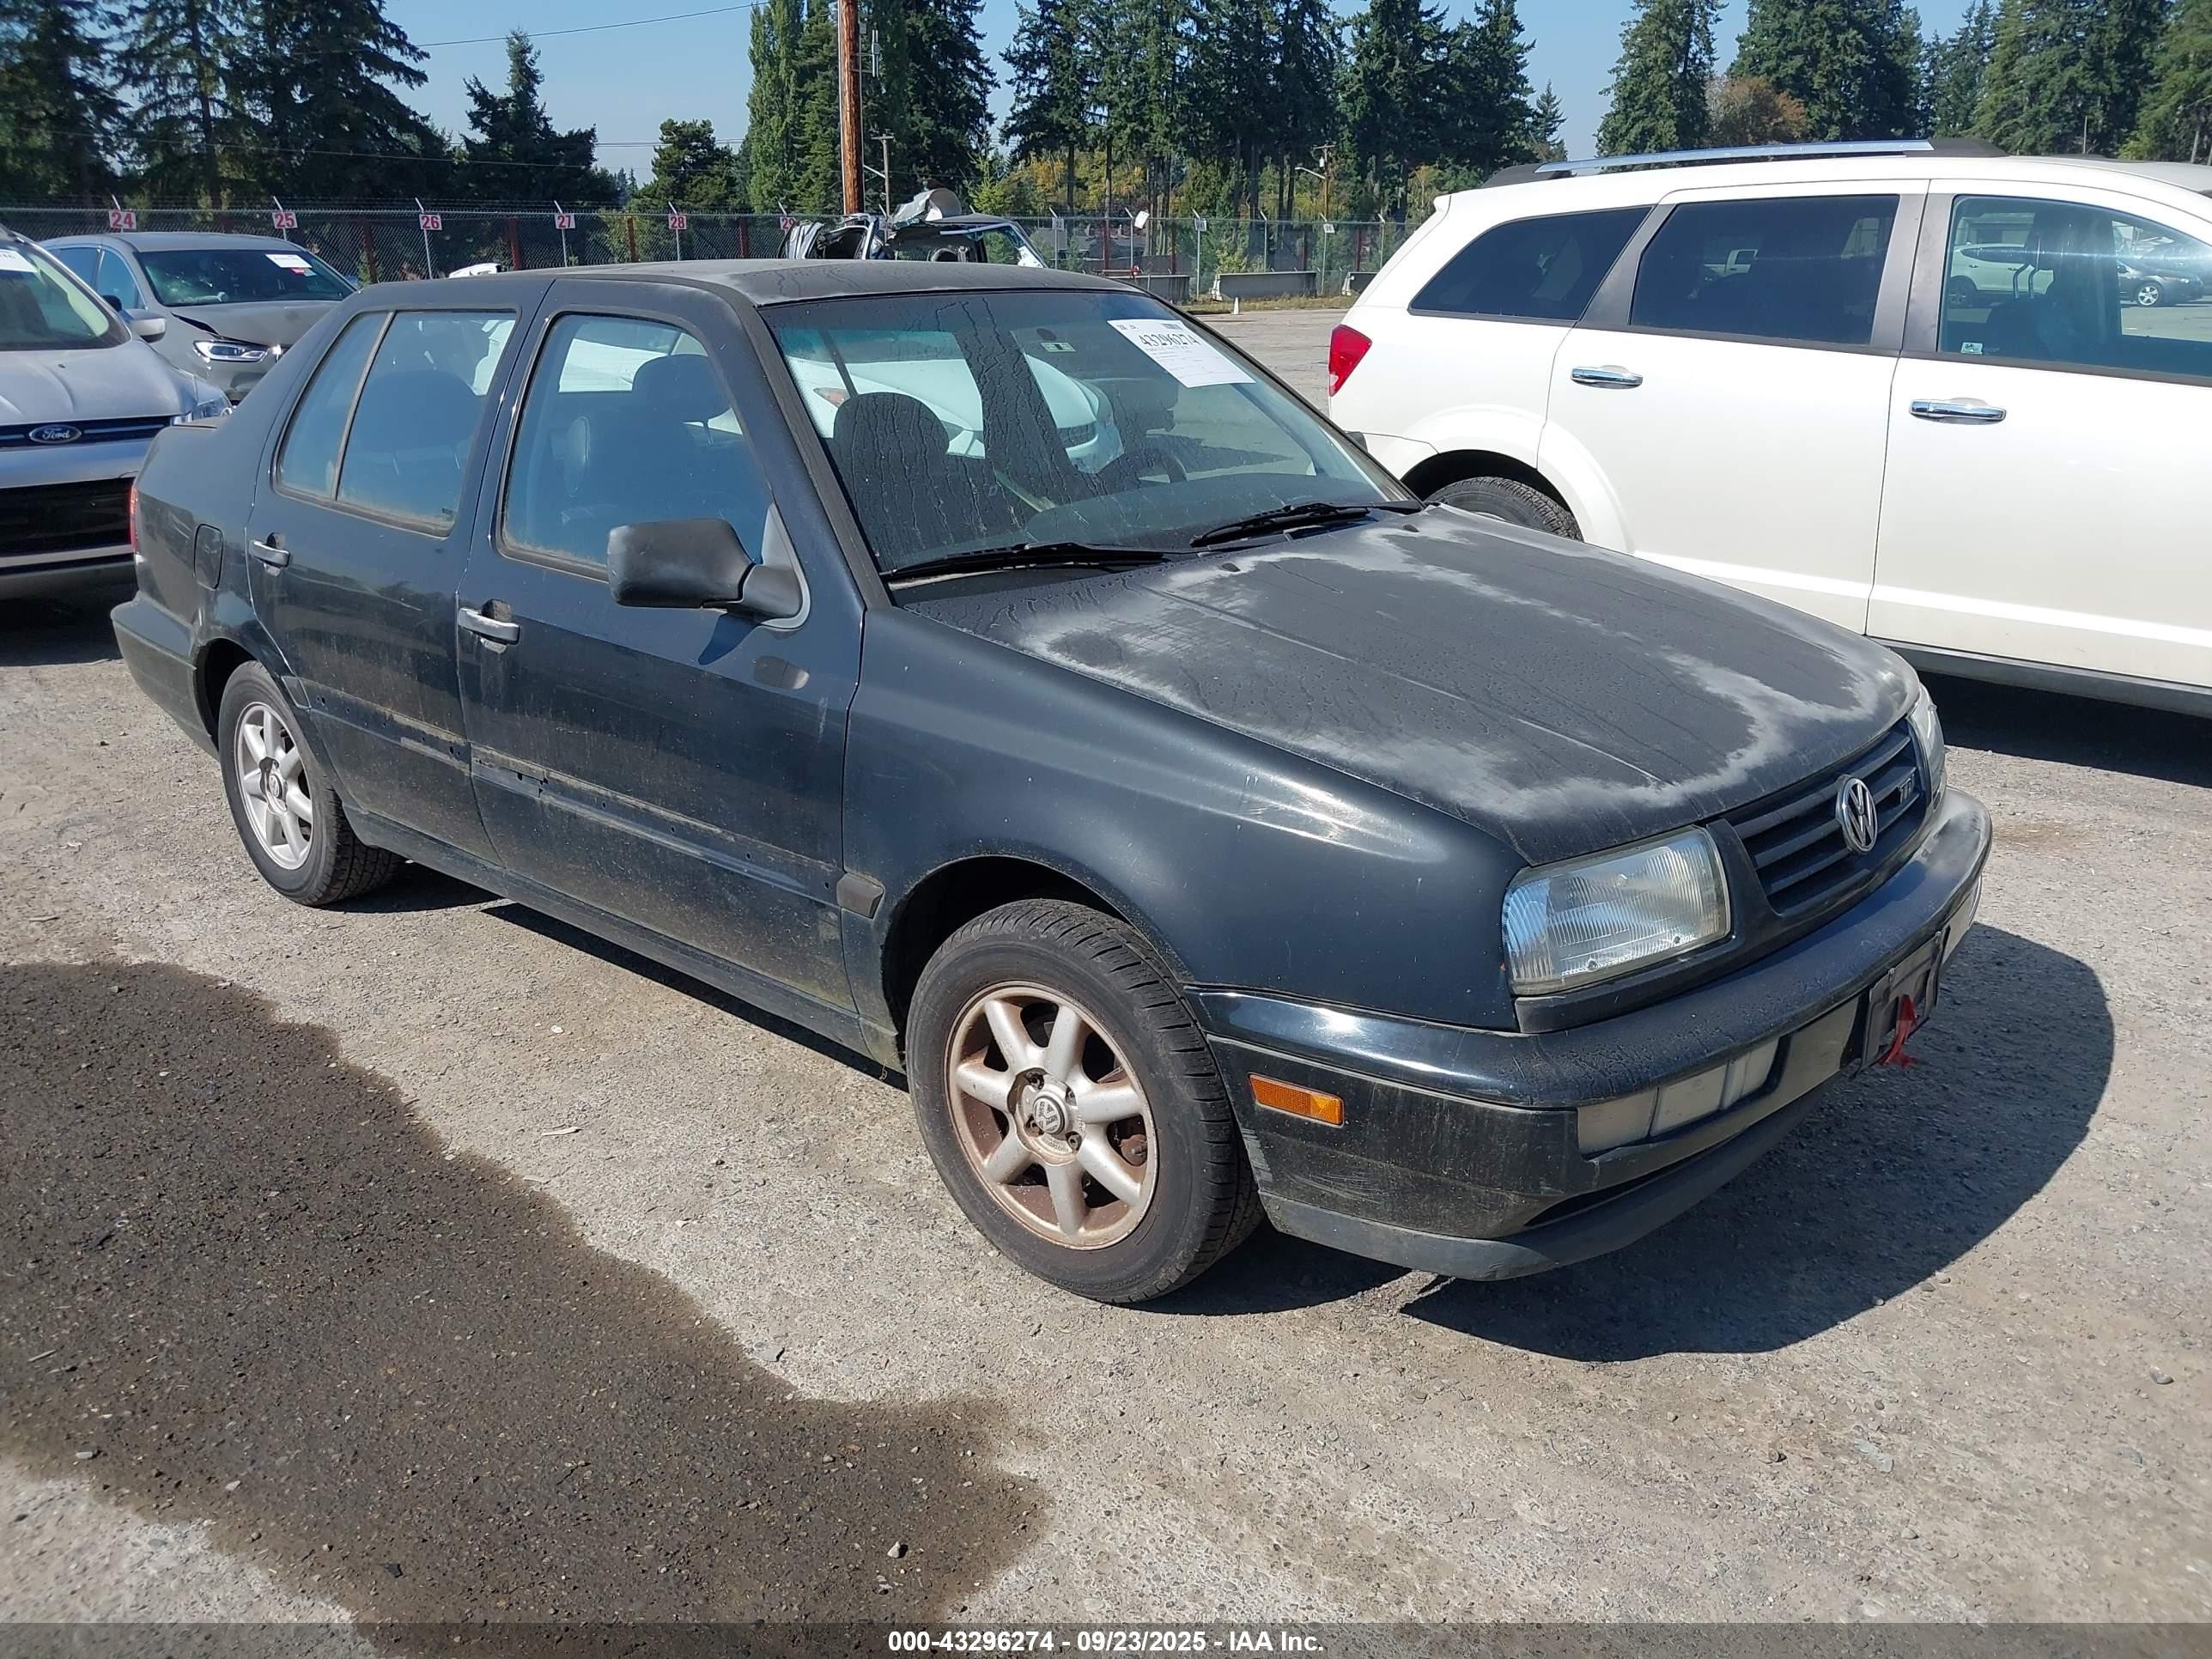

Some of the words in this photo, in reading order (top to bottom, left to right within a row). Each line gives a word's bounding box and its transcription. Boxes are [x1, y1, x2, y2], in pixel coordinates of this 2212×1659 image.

[112, 211, 134, 228] 24
[275, 213, 295, 228] 25
[422, 216, 440, 229] 26
[557, 215, 571, 228] 27
[671, 216, 684, 228] 28
[1139, 333, 1201, 347] 43296274
[42, 428, 70, 440] Ford
